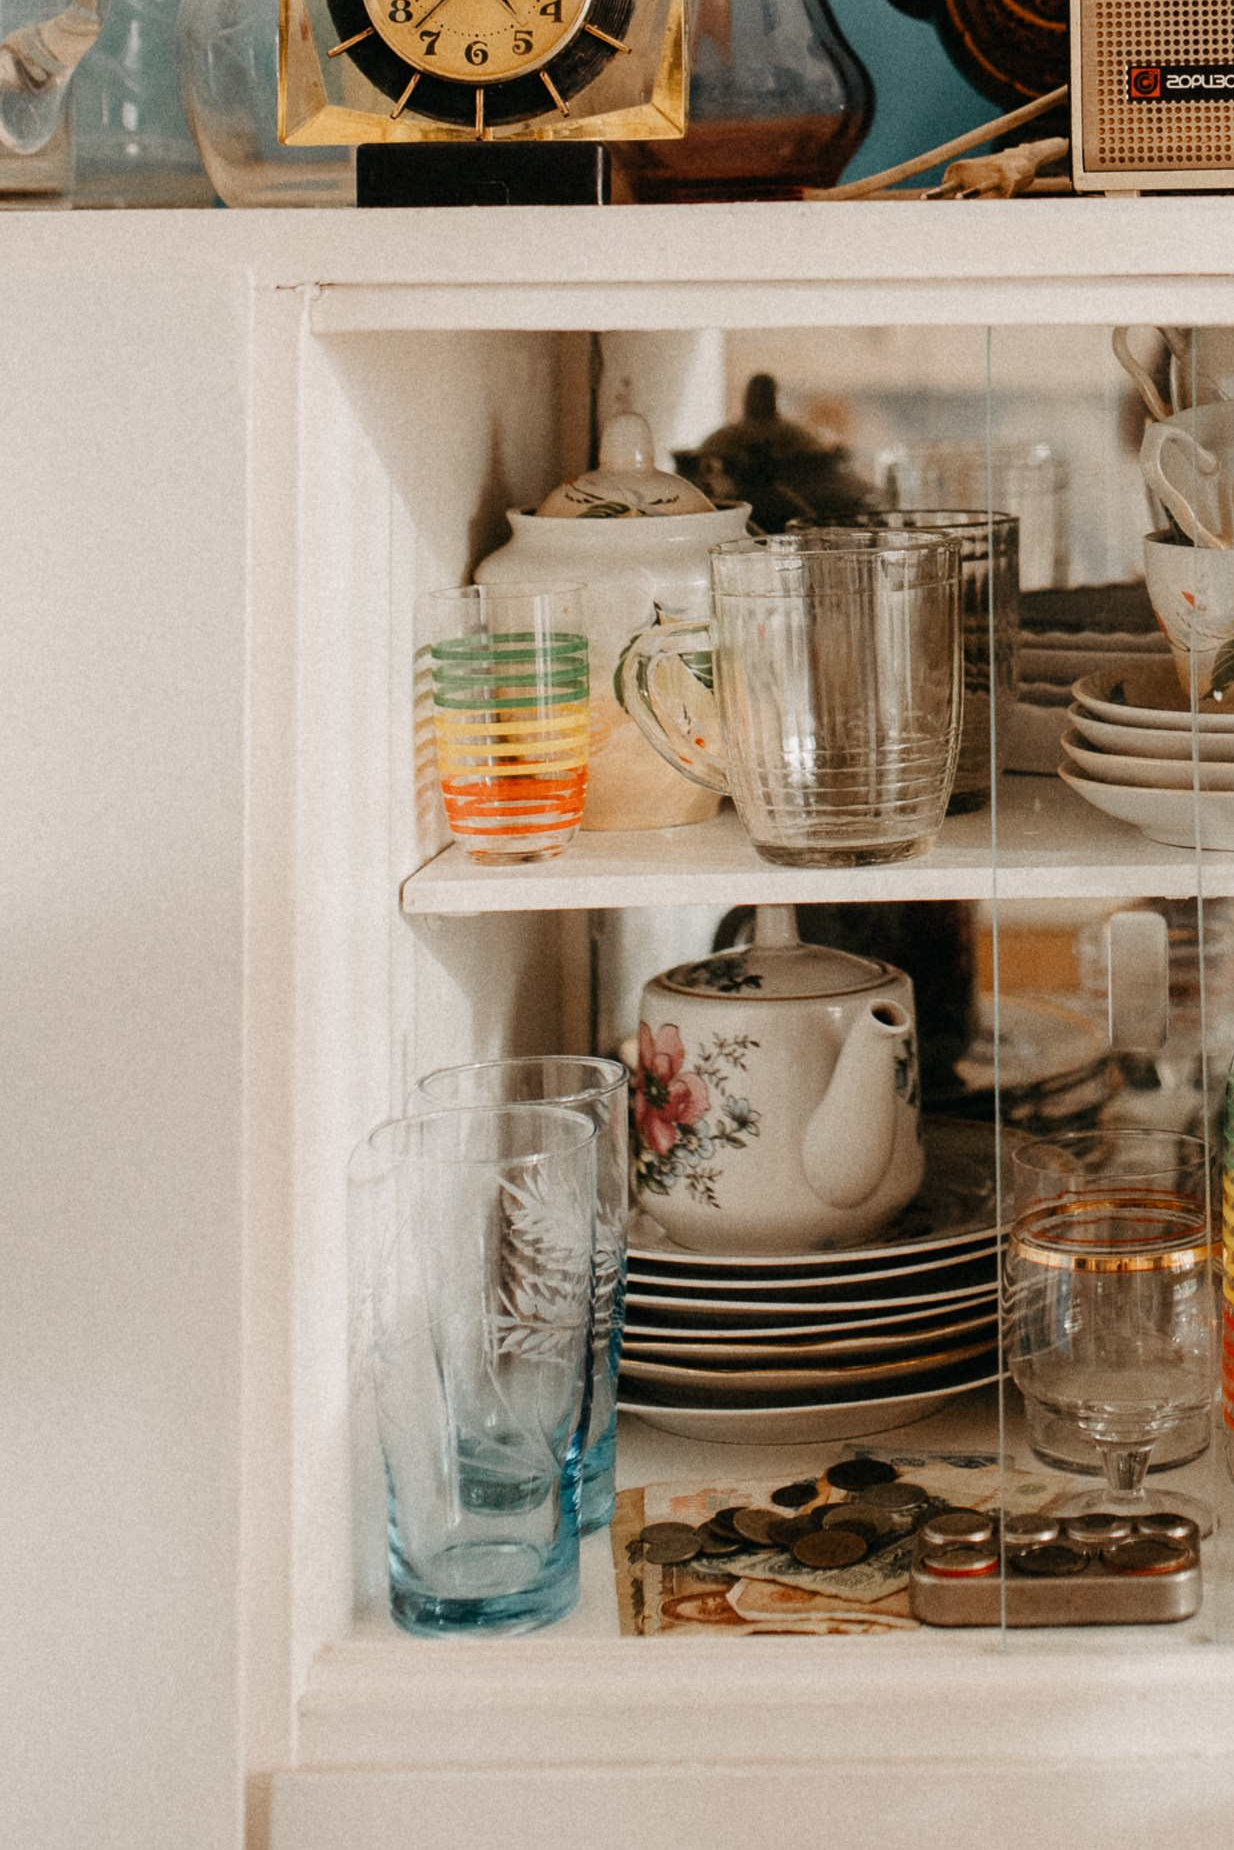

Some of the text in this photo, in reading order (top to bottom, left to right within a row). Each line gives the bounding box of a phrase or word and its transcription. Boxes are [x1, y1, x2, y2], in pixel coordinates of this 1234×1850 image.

[420, 30, 441, 55] 7
[465, 40, 488, 65] 6
[512, 30, 533, 55] 5
